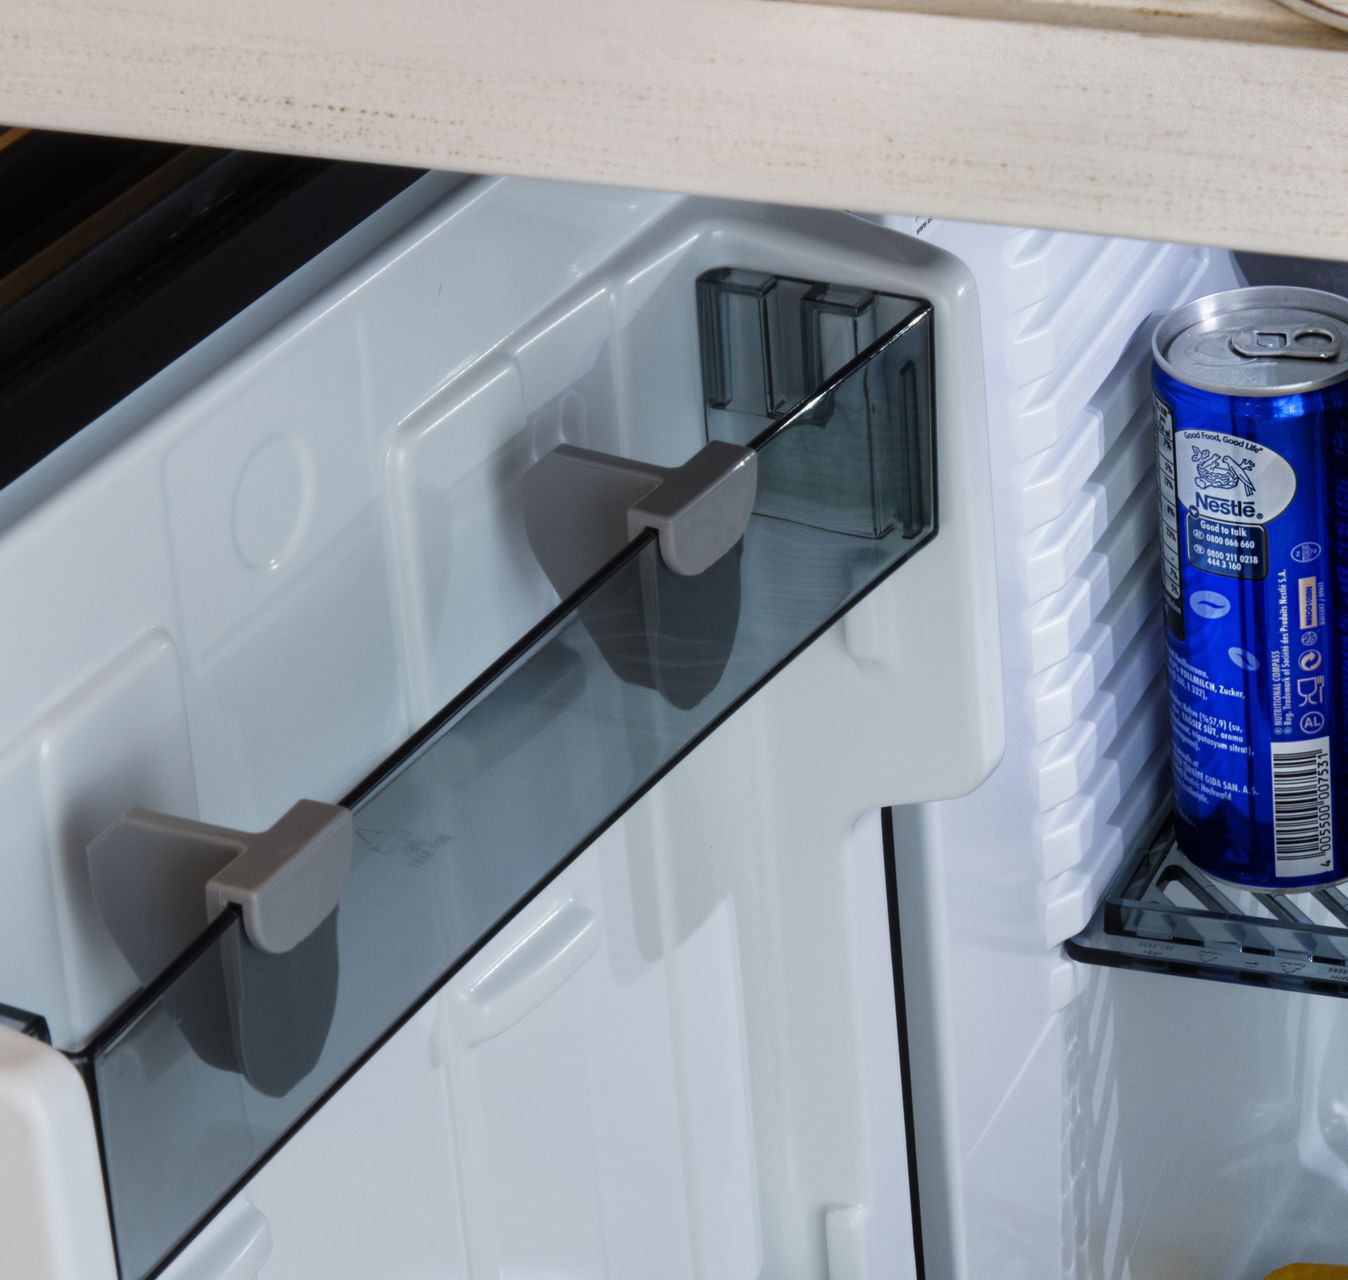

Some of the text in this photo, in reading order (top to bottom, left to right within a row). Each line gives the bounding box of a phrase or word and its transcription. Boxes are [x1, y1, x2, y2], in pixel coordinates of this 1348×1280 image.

[1184, 431, 1200, 440] Good
[1201, 432, 1220, 442] Food,
[1223, 436, 1244, 447] Good
[1200, 520, 1247, 536] Good to talk
[1206, 535, 1255, 549] 0800 066 660
[1207, 549, 1259, 564] 0800 211 0218
[1208, 558, 1220, 568] 444
[1228, 562, 1242, 571] 160
[1279, 606, 1289, 632] Produits
[1271, 650, 1282, 726] NUTRITIONAL COMPASS
[1304, 716, 1321, 729] AL
[1220, 732, 1244, 743] aroma
